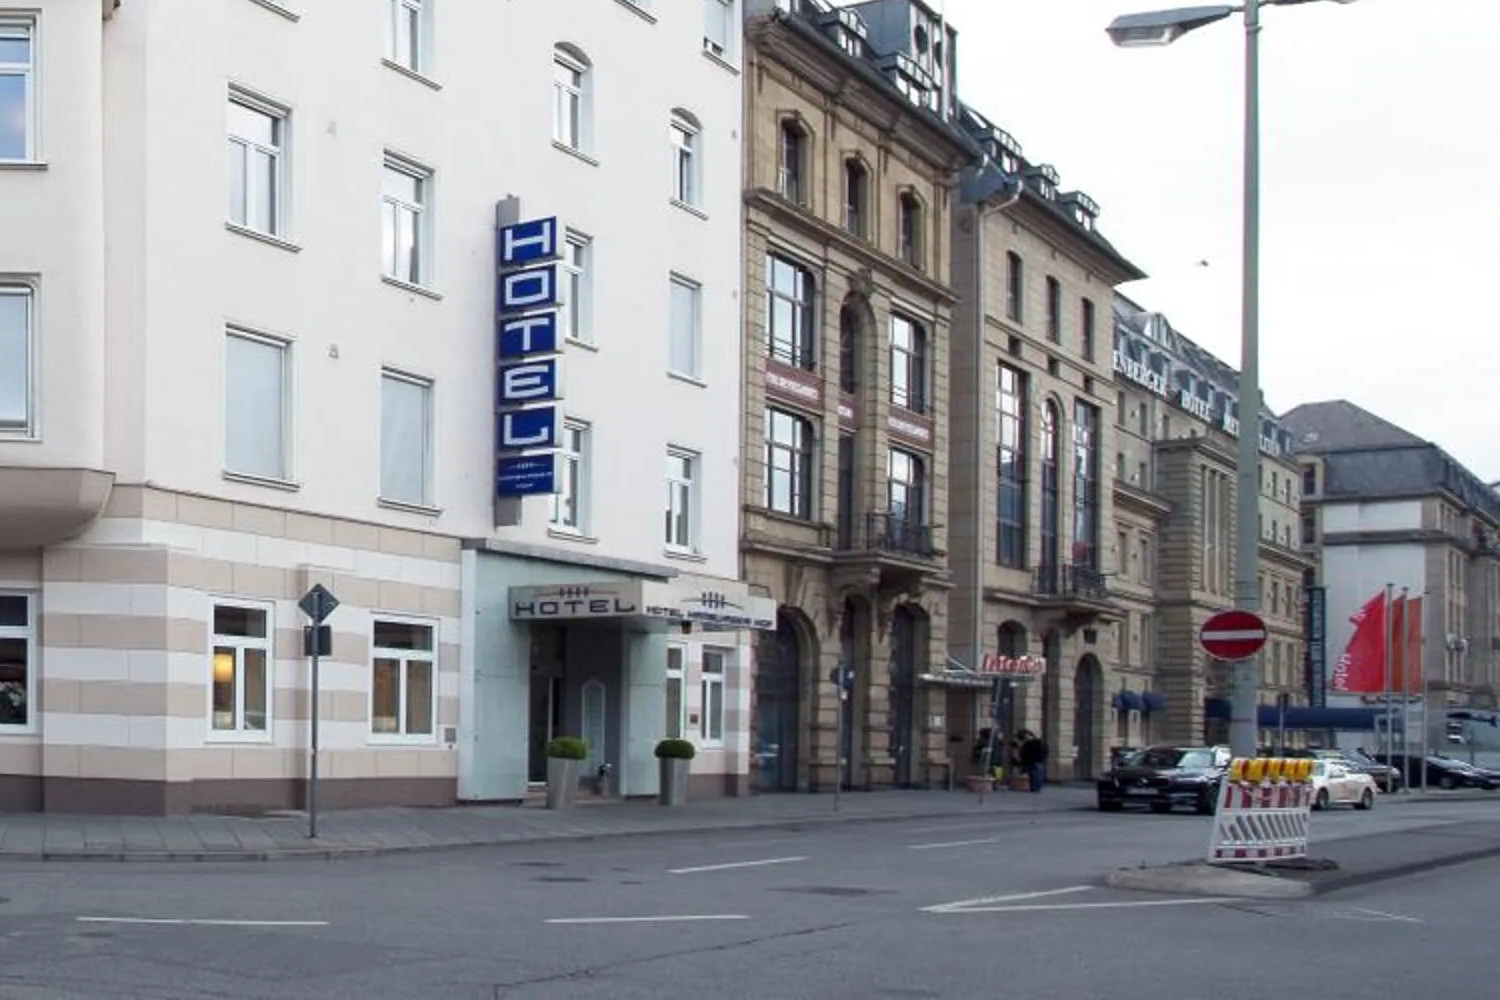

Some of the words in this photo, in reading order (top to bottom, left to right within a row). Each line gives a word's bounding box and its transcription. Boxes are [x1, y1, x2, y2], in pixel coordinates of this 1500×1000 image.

[503, 221, 551, 447] HOTEL
[1182, 389, 1212, 423] HOTEL
[515, 597, 636, 616] HOTEL
